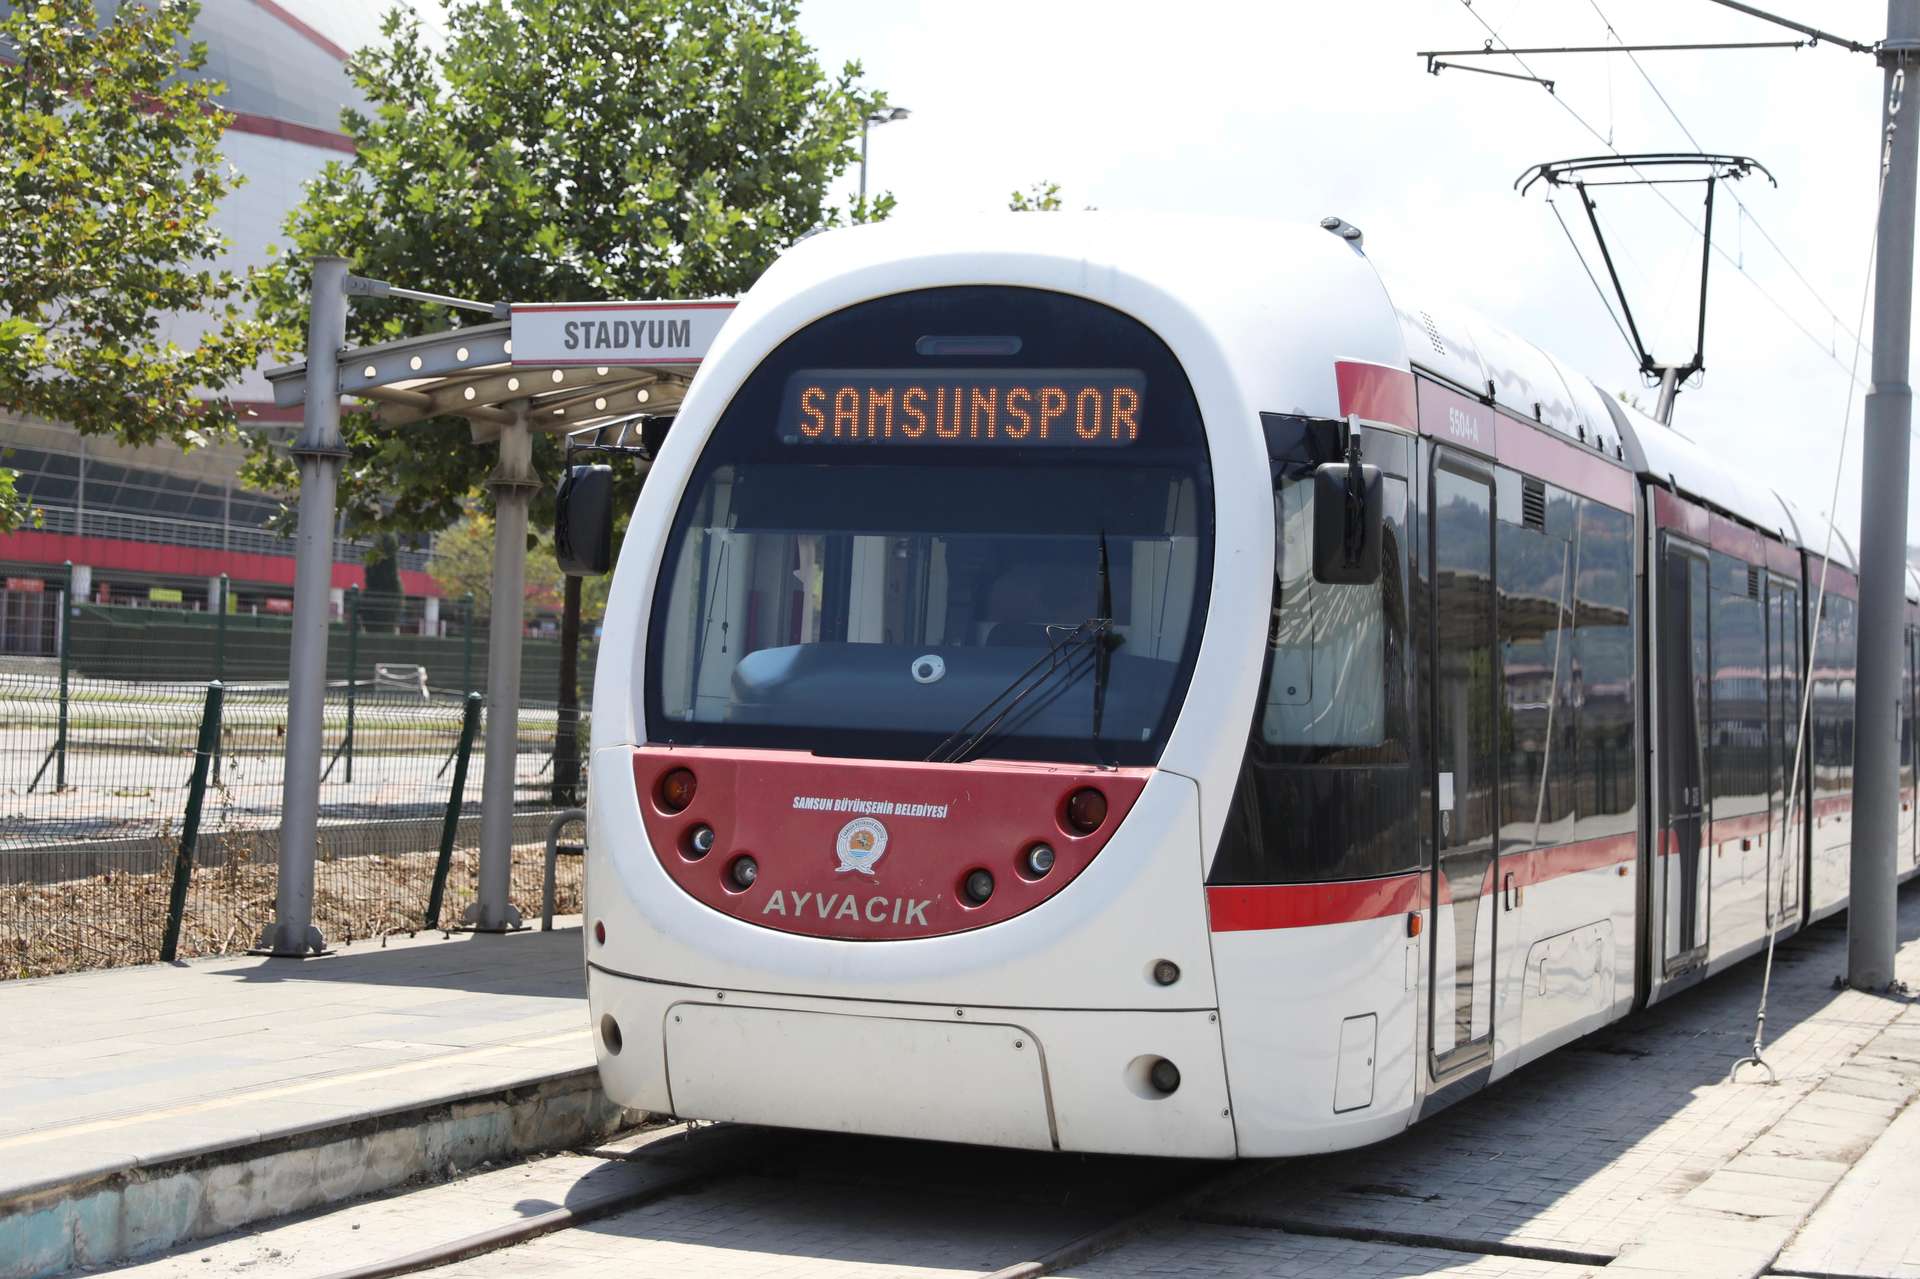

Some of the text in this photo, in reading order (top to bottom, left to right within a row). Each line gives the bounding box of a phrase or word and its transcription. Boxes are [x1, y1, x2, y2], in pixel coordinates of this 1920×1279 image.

[564, 319, 691, 350] STADYUM
[800, 387, 1138, 440] SAMSUNSPOR
[1449, 407, 1479, 443] 5504-A
[792, 796, 948, 819] SAMSUN BÜYÜKŞEHİR BELEDİYESİ
[762, 889, 932, 926] AYVACIK
